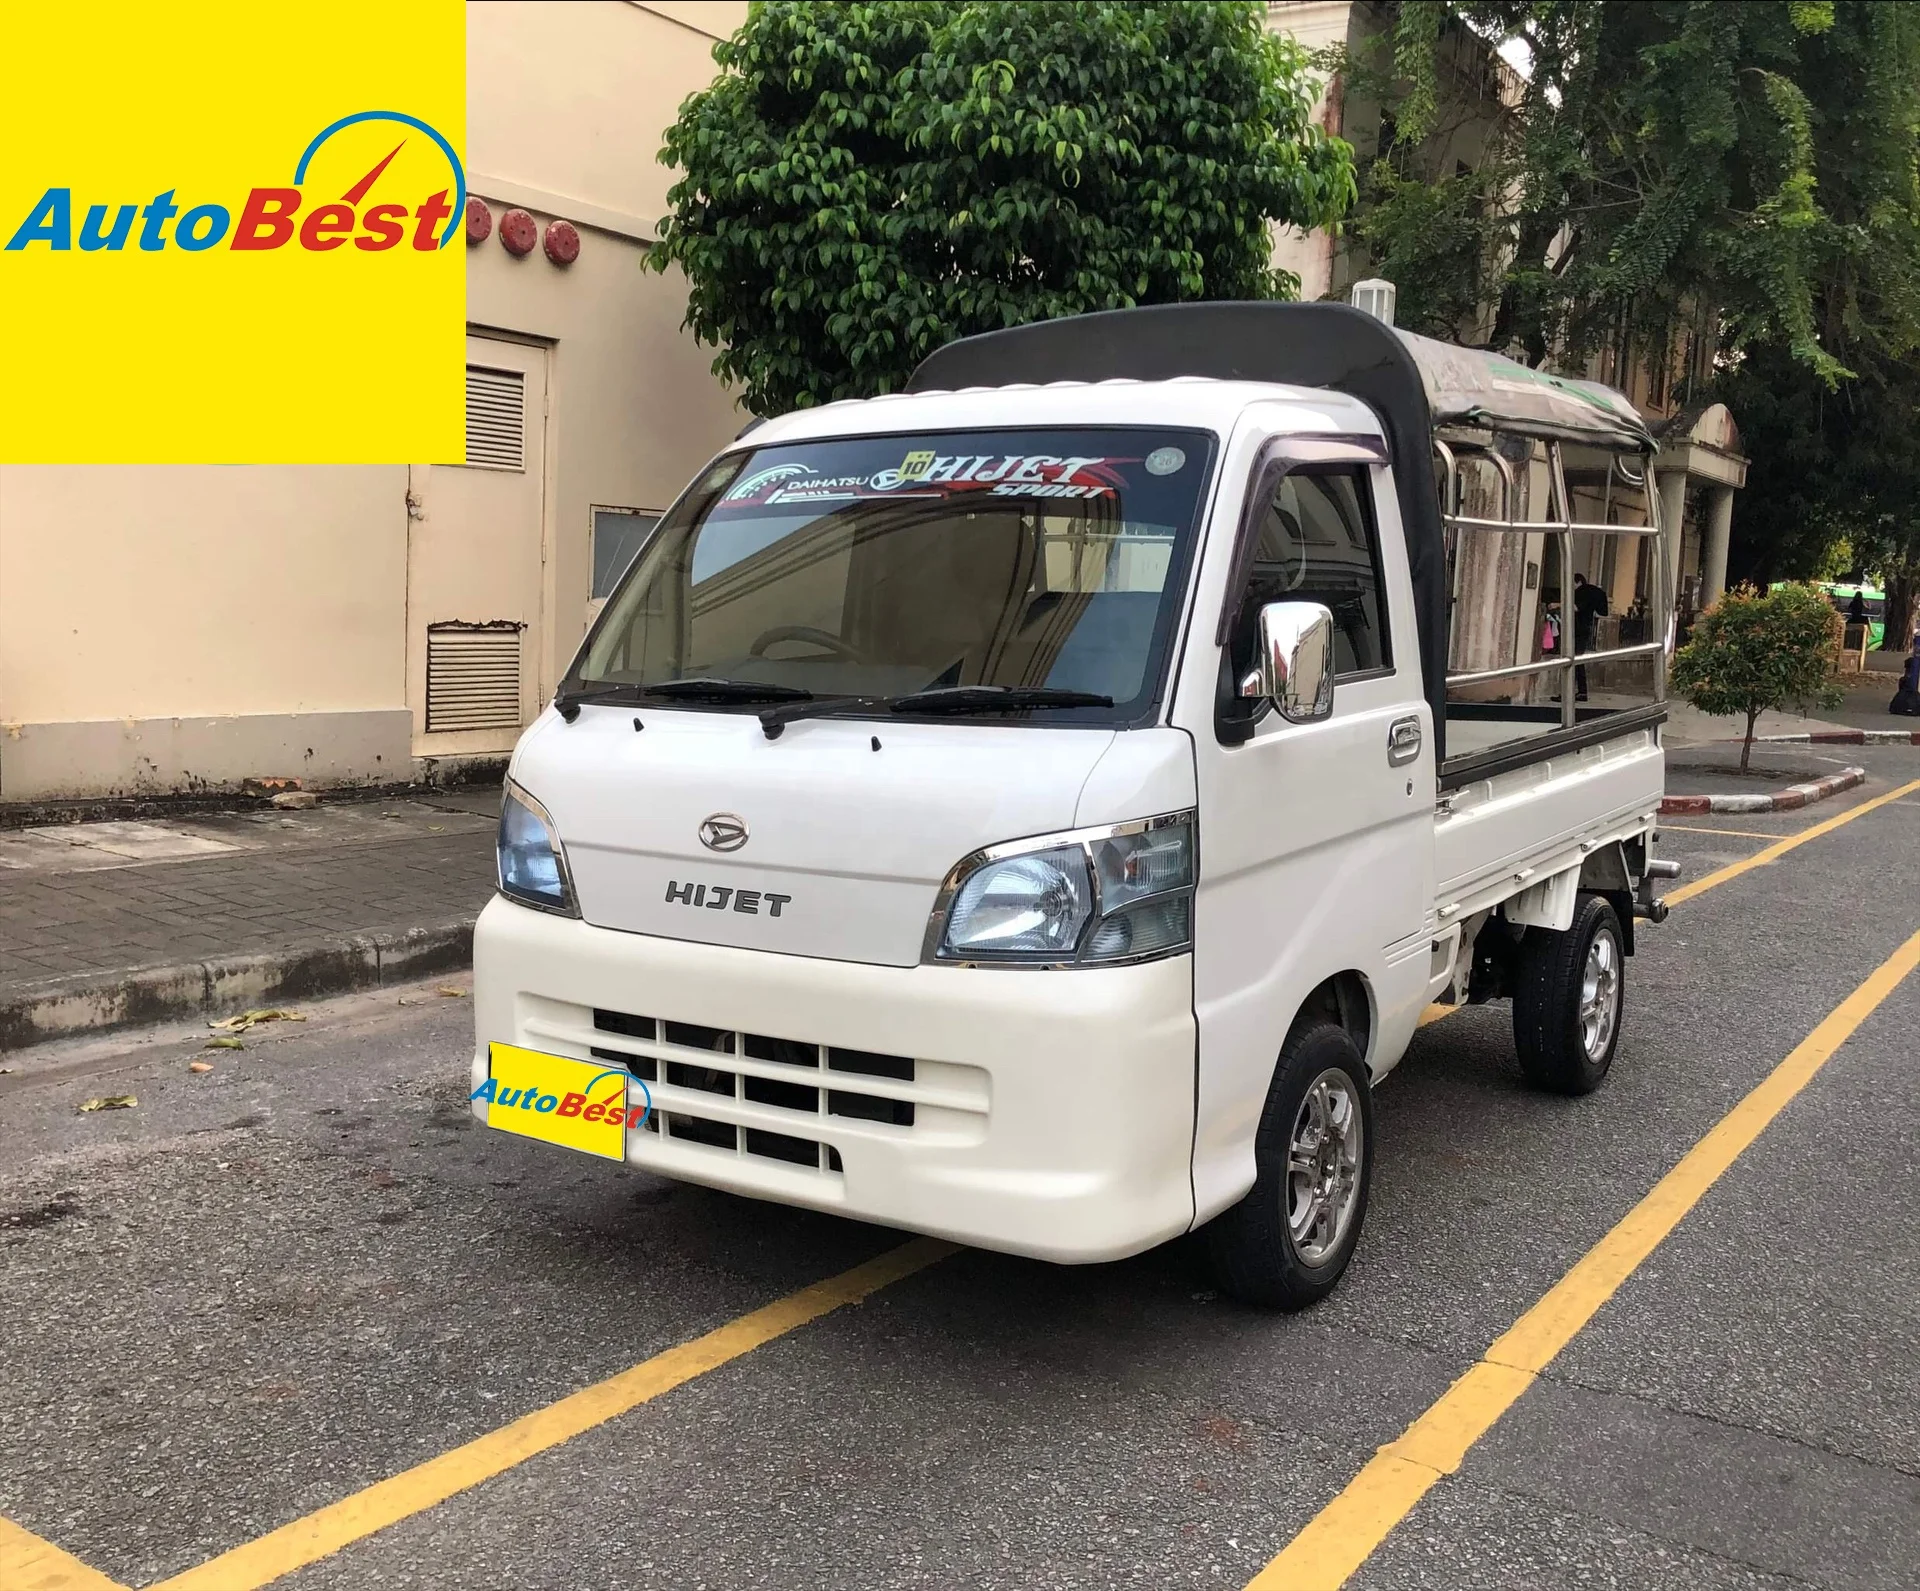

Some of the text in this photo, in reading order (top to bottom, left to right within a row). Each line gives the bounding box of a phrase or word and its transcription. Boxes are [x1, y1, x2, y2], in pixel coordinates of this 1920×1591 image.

[902, 460, 928, 475] 10
[914, 455, 1105, 483] HIJET
[787, 476, 870, 490] DAIHATSU
[986, 483, 1114, 499] SPORT
[664, 880, 792, 918] HIJET
